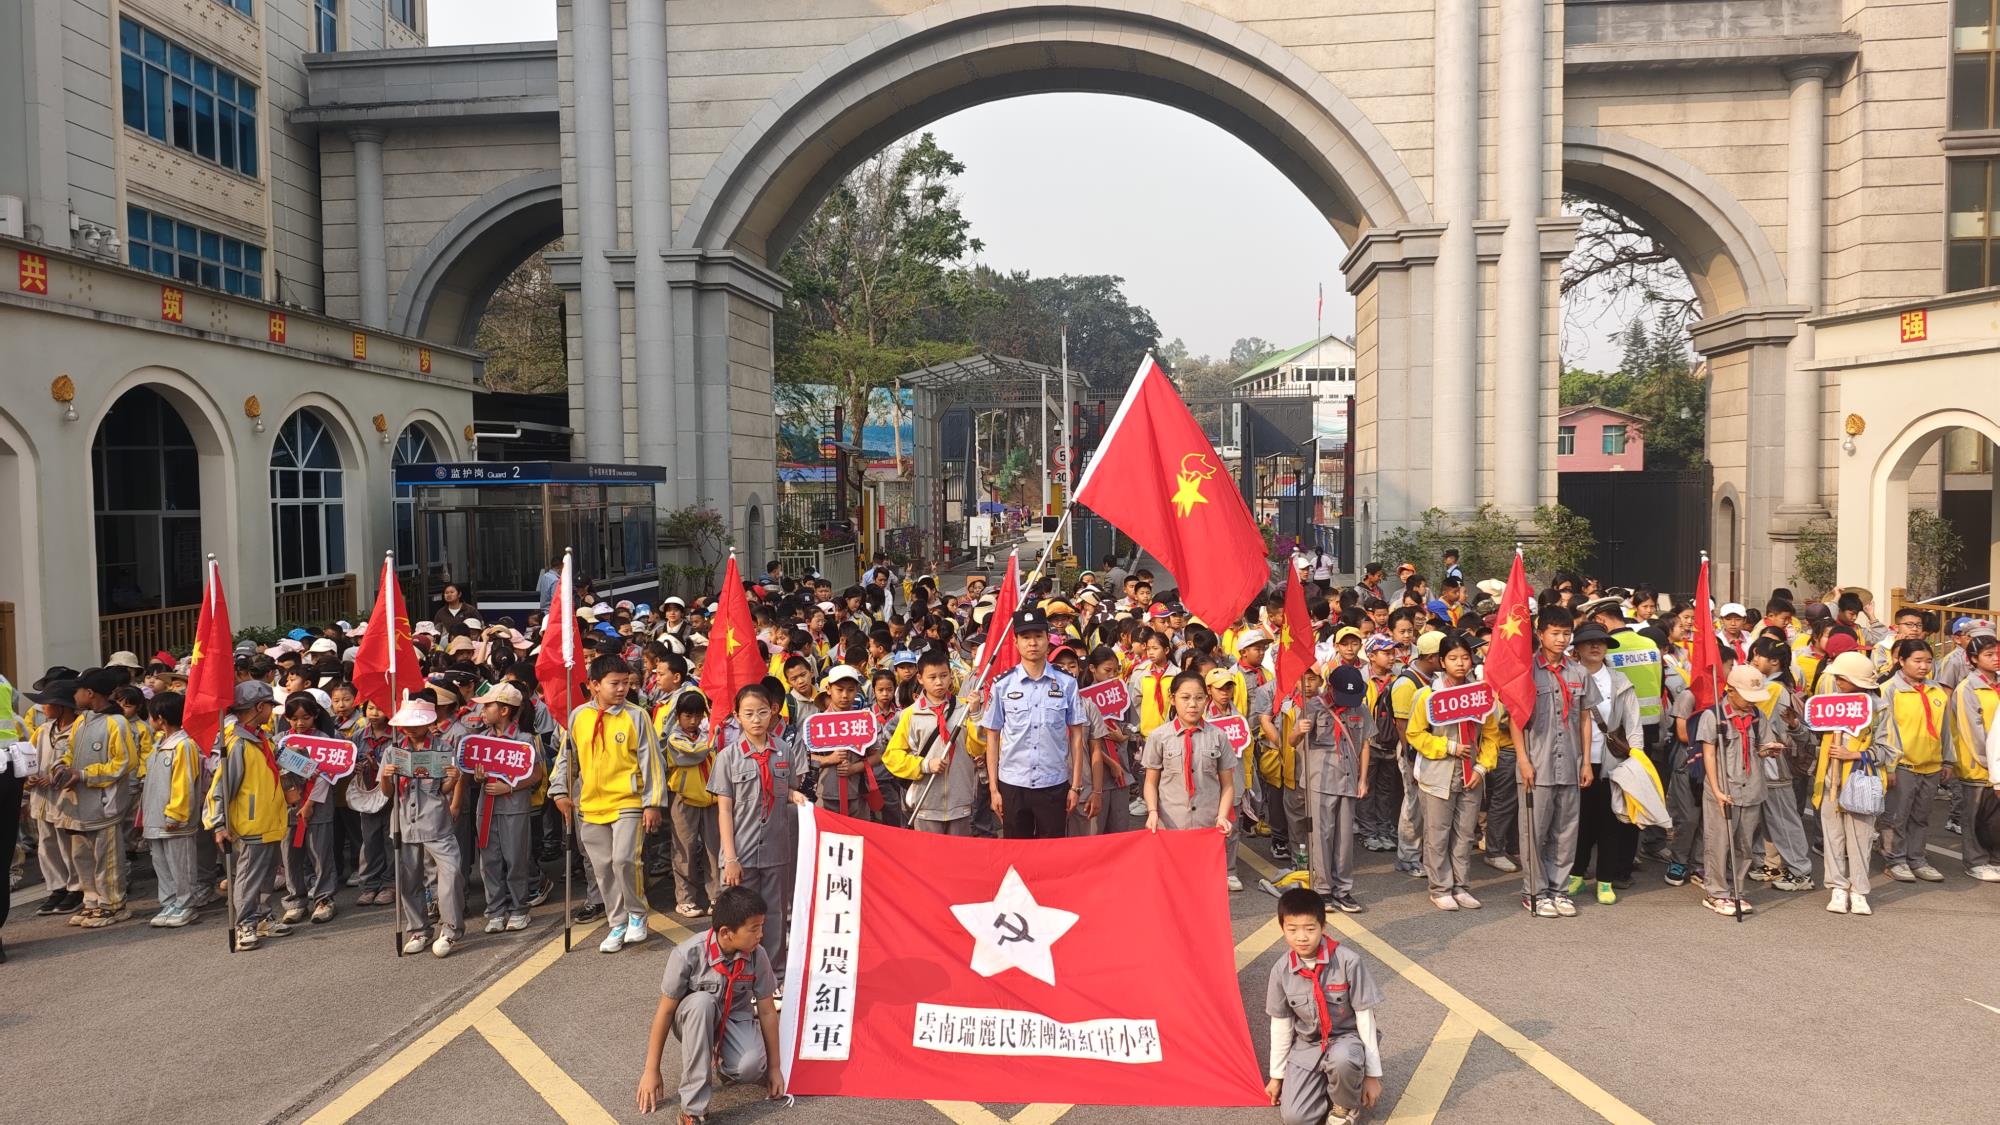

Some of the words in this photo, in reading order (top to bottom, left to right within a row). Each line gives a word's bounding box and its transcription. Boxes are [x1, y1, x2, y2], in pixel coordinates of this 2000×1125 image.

[1902, 311, 1925, 340] 强
[451, 468, 484, 478] 监护岗
[487, 471, 507, 479] Guard
[512, 466, 520, 478] 2
[1056, 472, 1067, 482] 30
[1625, 653, 1648, 663] POLICE
[1437, 690, 1488, 714] 108班
[1815, 701, 1863, 718] 109班
[816, 719, 869, 738] 113班
[470, 745, 526, 768] 114班
[809, 842, 854, 1052] 中國工農紅軍
[918, 1011, 1157, 1058] 雲南瑞麗民族團結紅軍小學
